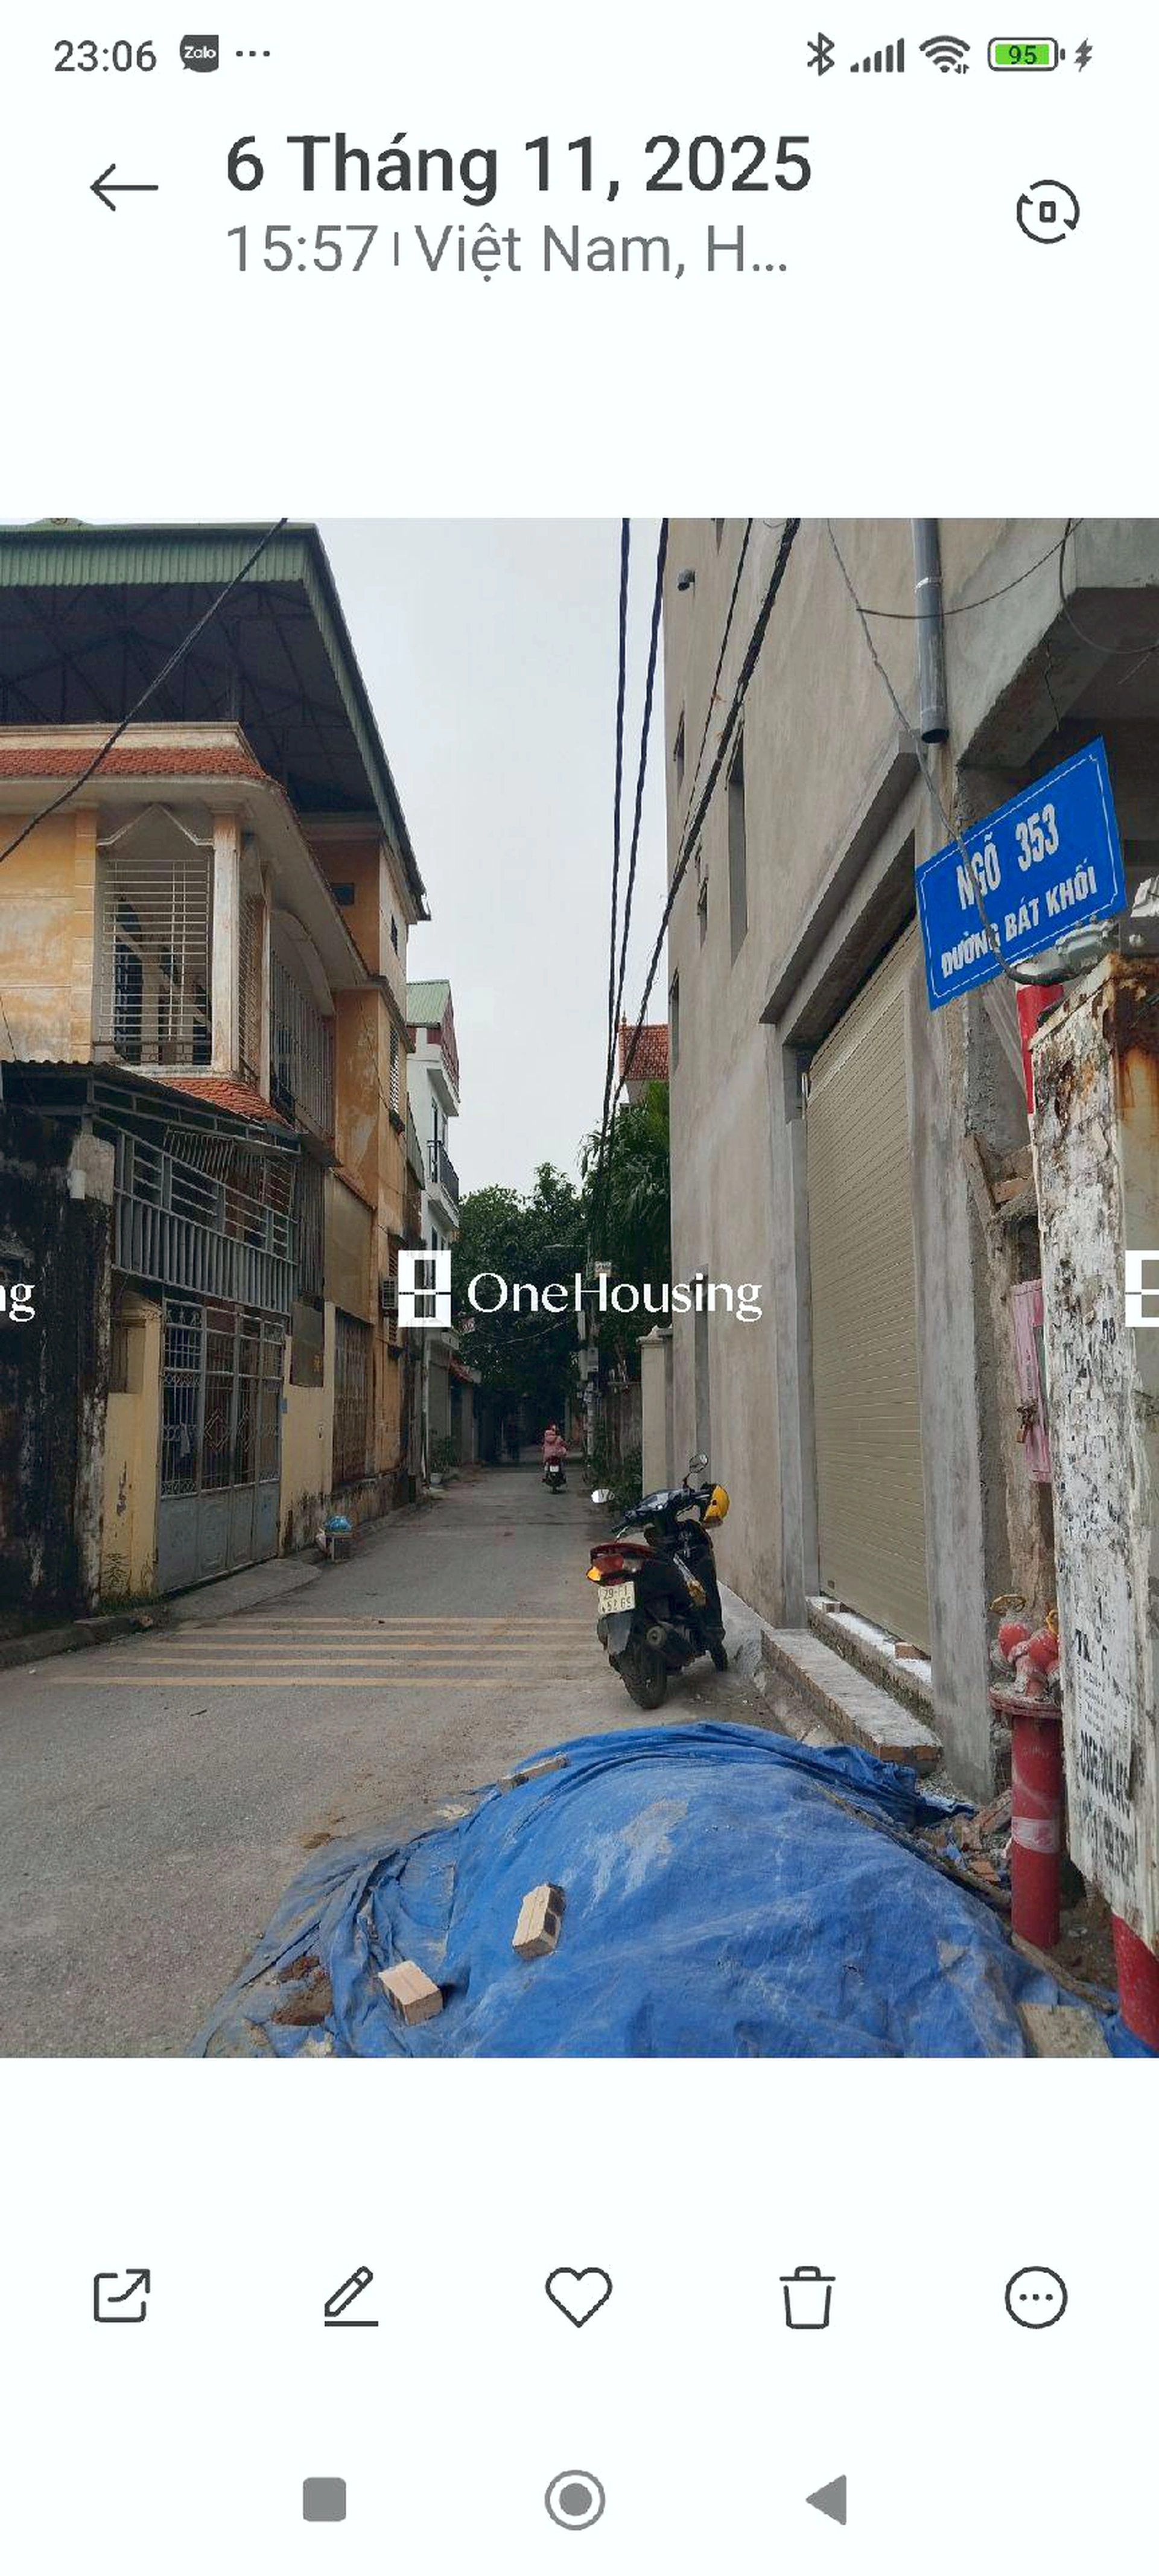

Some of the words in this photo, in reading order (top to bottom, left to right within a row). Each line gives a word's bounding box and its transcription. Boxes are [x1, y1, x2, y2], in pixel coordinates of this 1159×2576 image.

[956, 832, 1002, 911] NGÕ
[1015, 803, 1059, 871] 353
[1004, 895, 1040, 942] BÁT
[1045, 857, 1097, 917] KHỐI
